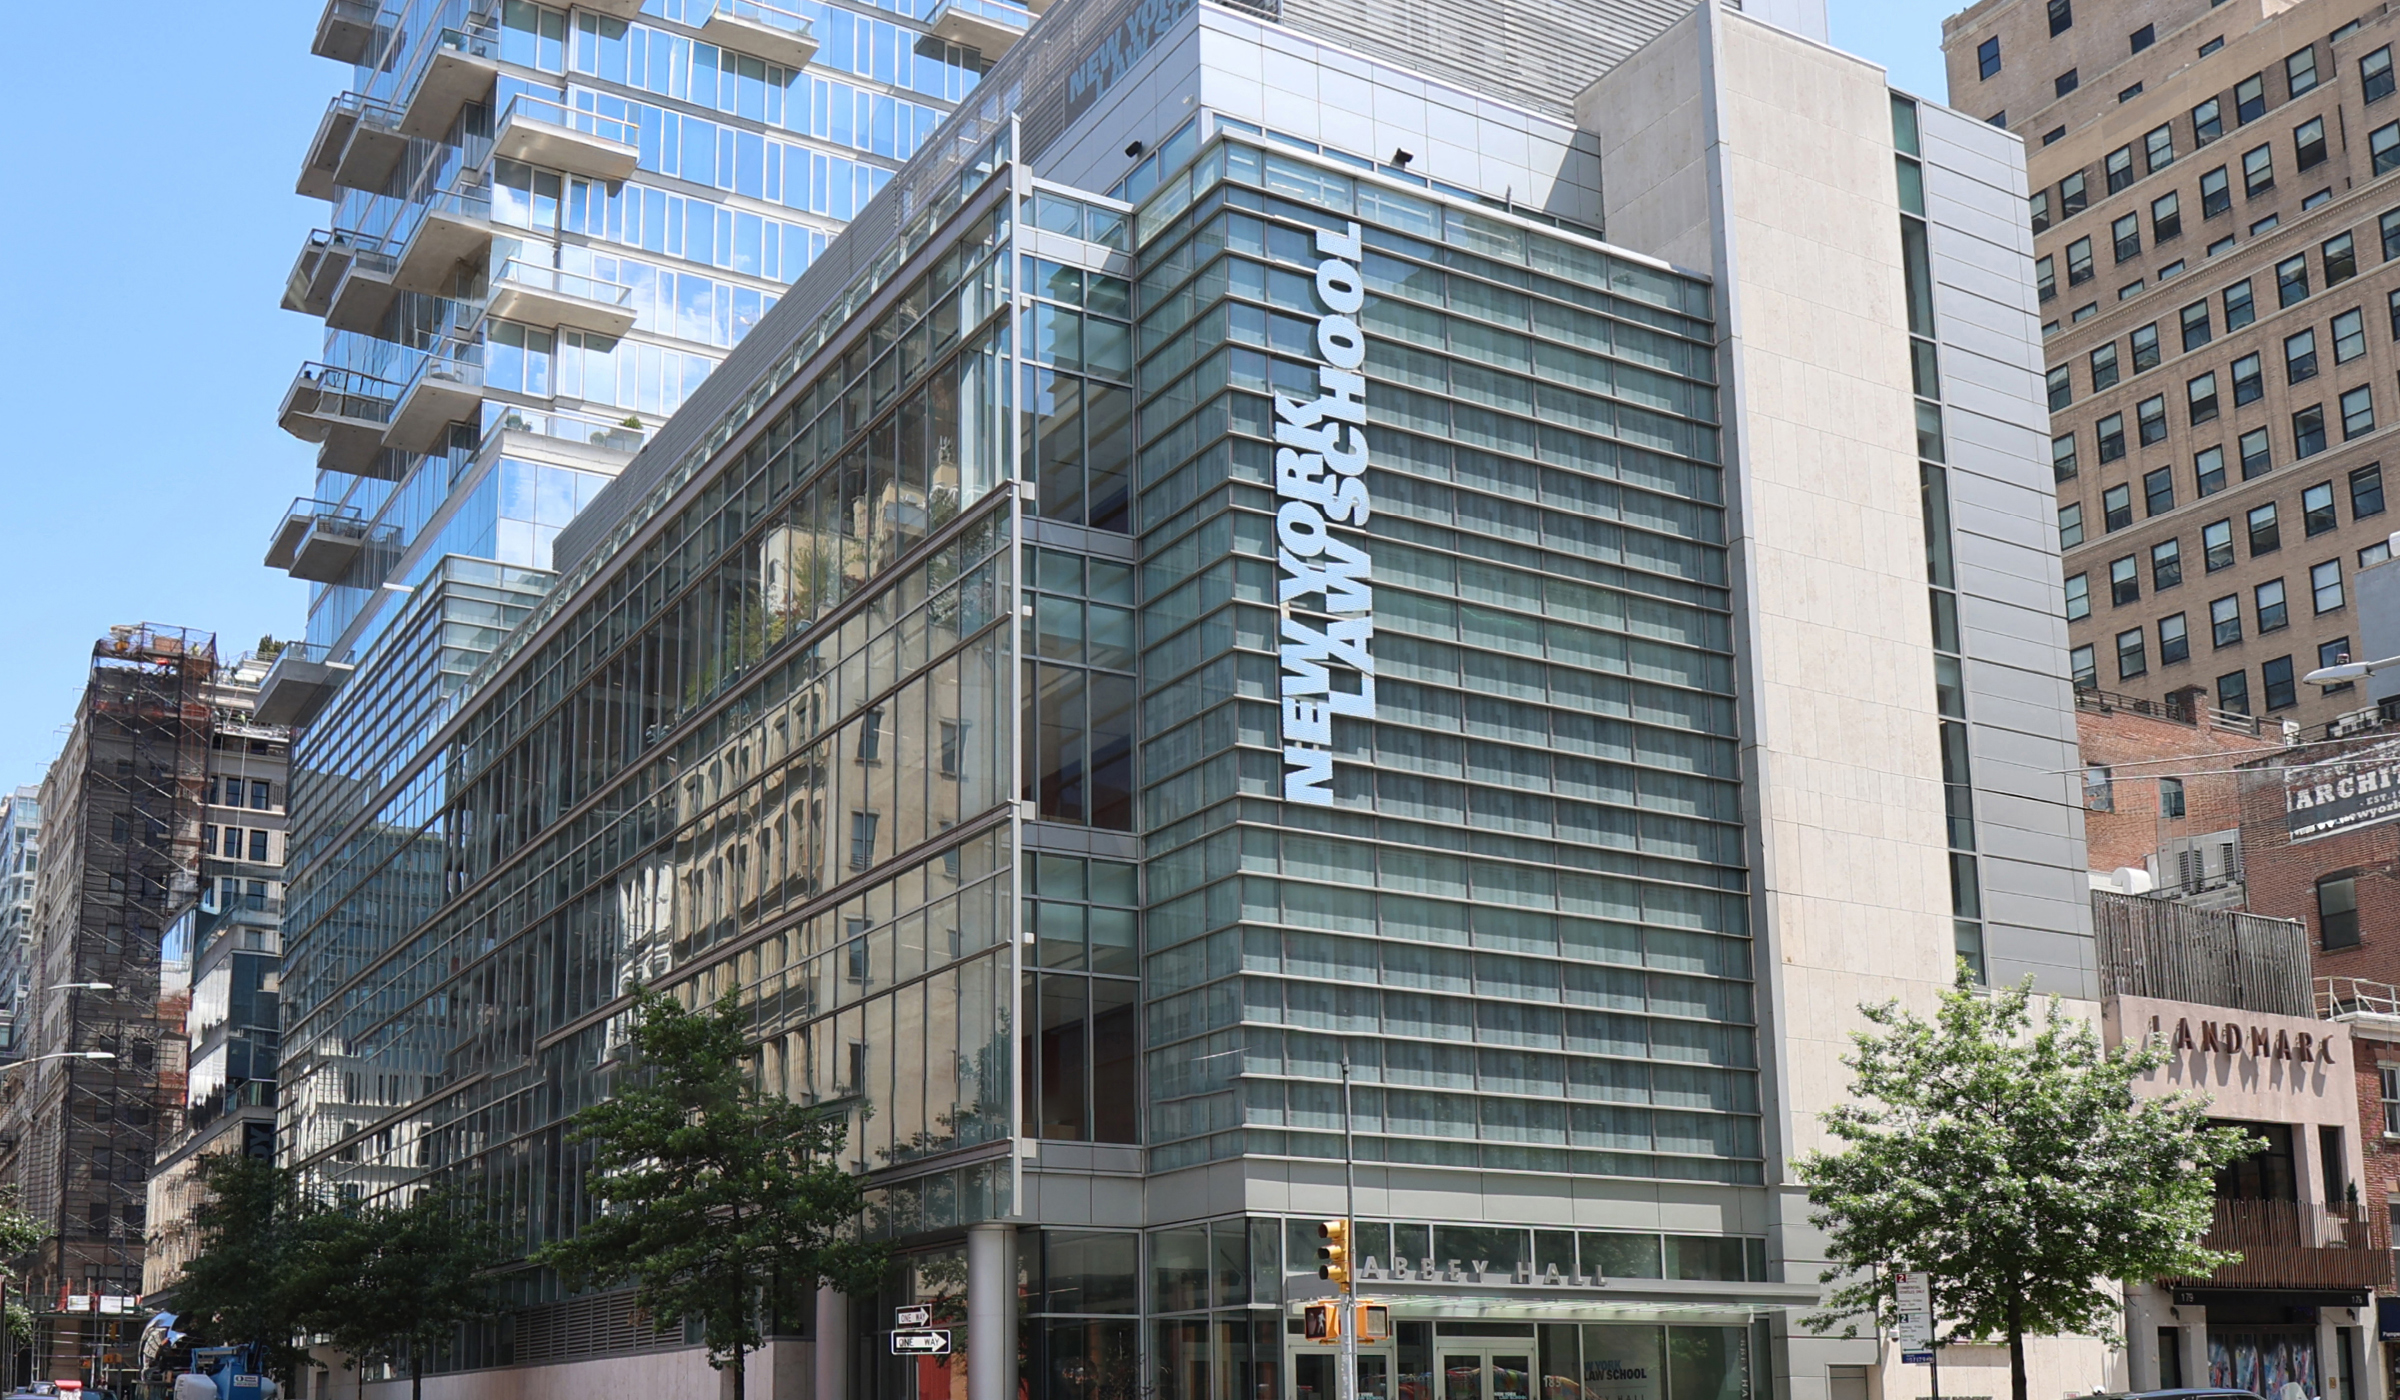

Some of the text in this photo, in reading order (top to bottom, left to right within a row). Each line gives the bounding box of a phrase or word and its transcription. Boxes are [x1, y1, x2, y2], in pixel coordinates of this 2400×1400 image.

[1070, 26, 1122, 104] NEW
[1316, 221, 1376, 720] LAW SCHOOL
[1275, 390, 1334, 808] NEW YORK
[1362, 1255, 1608, 1287] ABBEY HALL
[901, 1313, 926, 1323] ONE WAY
[899, 1337, 940, 1347] ONE WAY
[1606, 1368, 1647, 1380] SCHOOL
